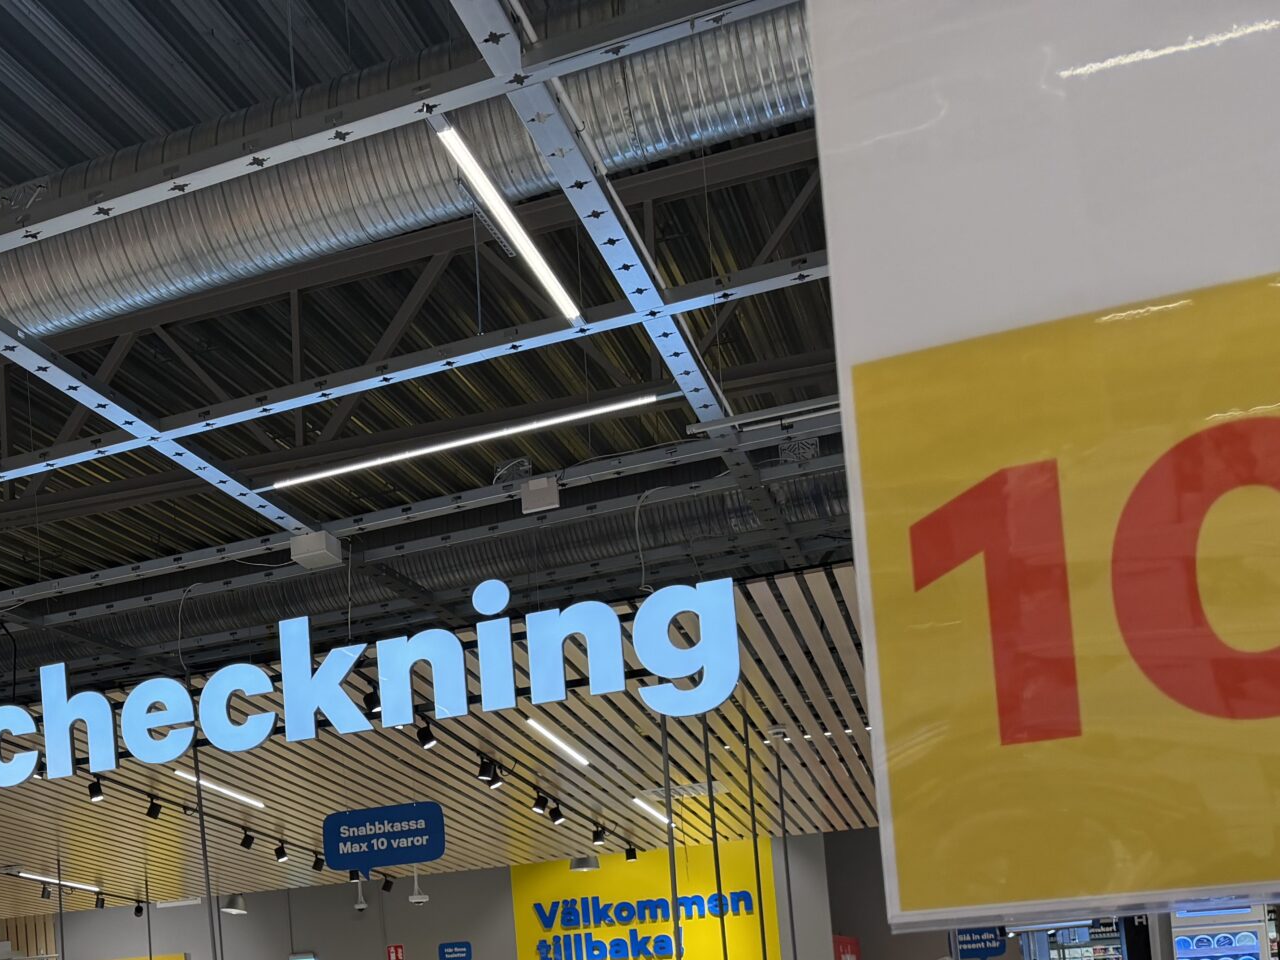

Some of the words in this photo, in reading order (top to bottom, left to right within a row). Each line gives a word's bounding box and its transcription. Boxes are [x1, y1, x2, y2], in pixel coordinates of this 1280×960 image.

[339, 817, 426, 838] Snabbkassa
[338, 840, 368, 855] Max
[371, 838, 388, 851] 10
[391, 834, 429, 849] varor
[533, 889, 754, 930] Välkommen
[958, 941, 985, 950] resent
